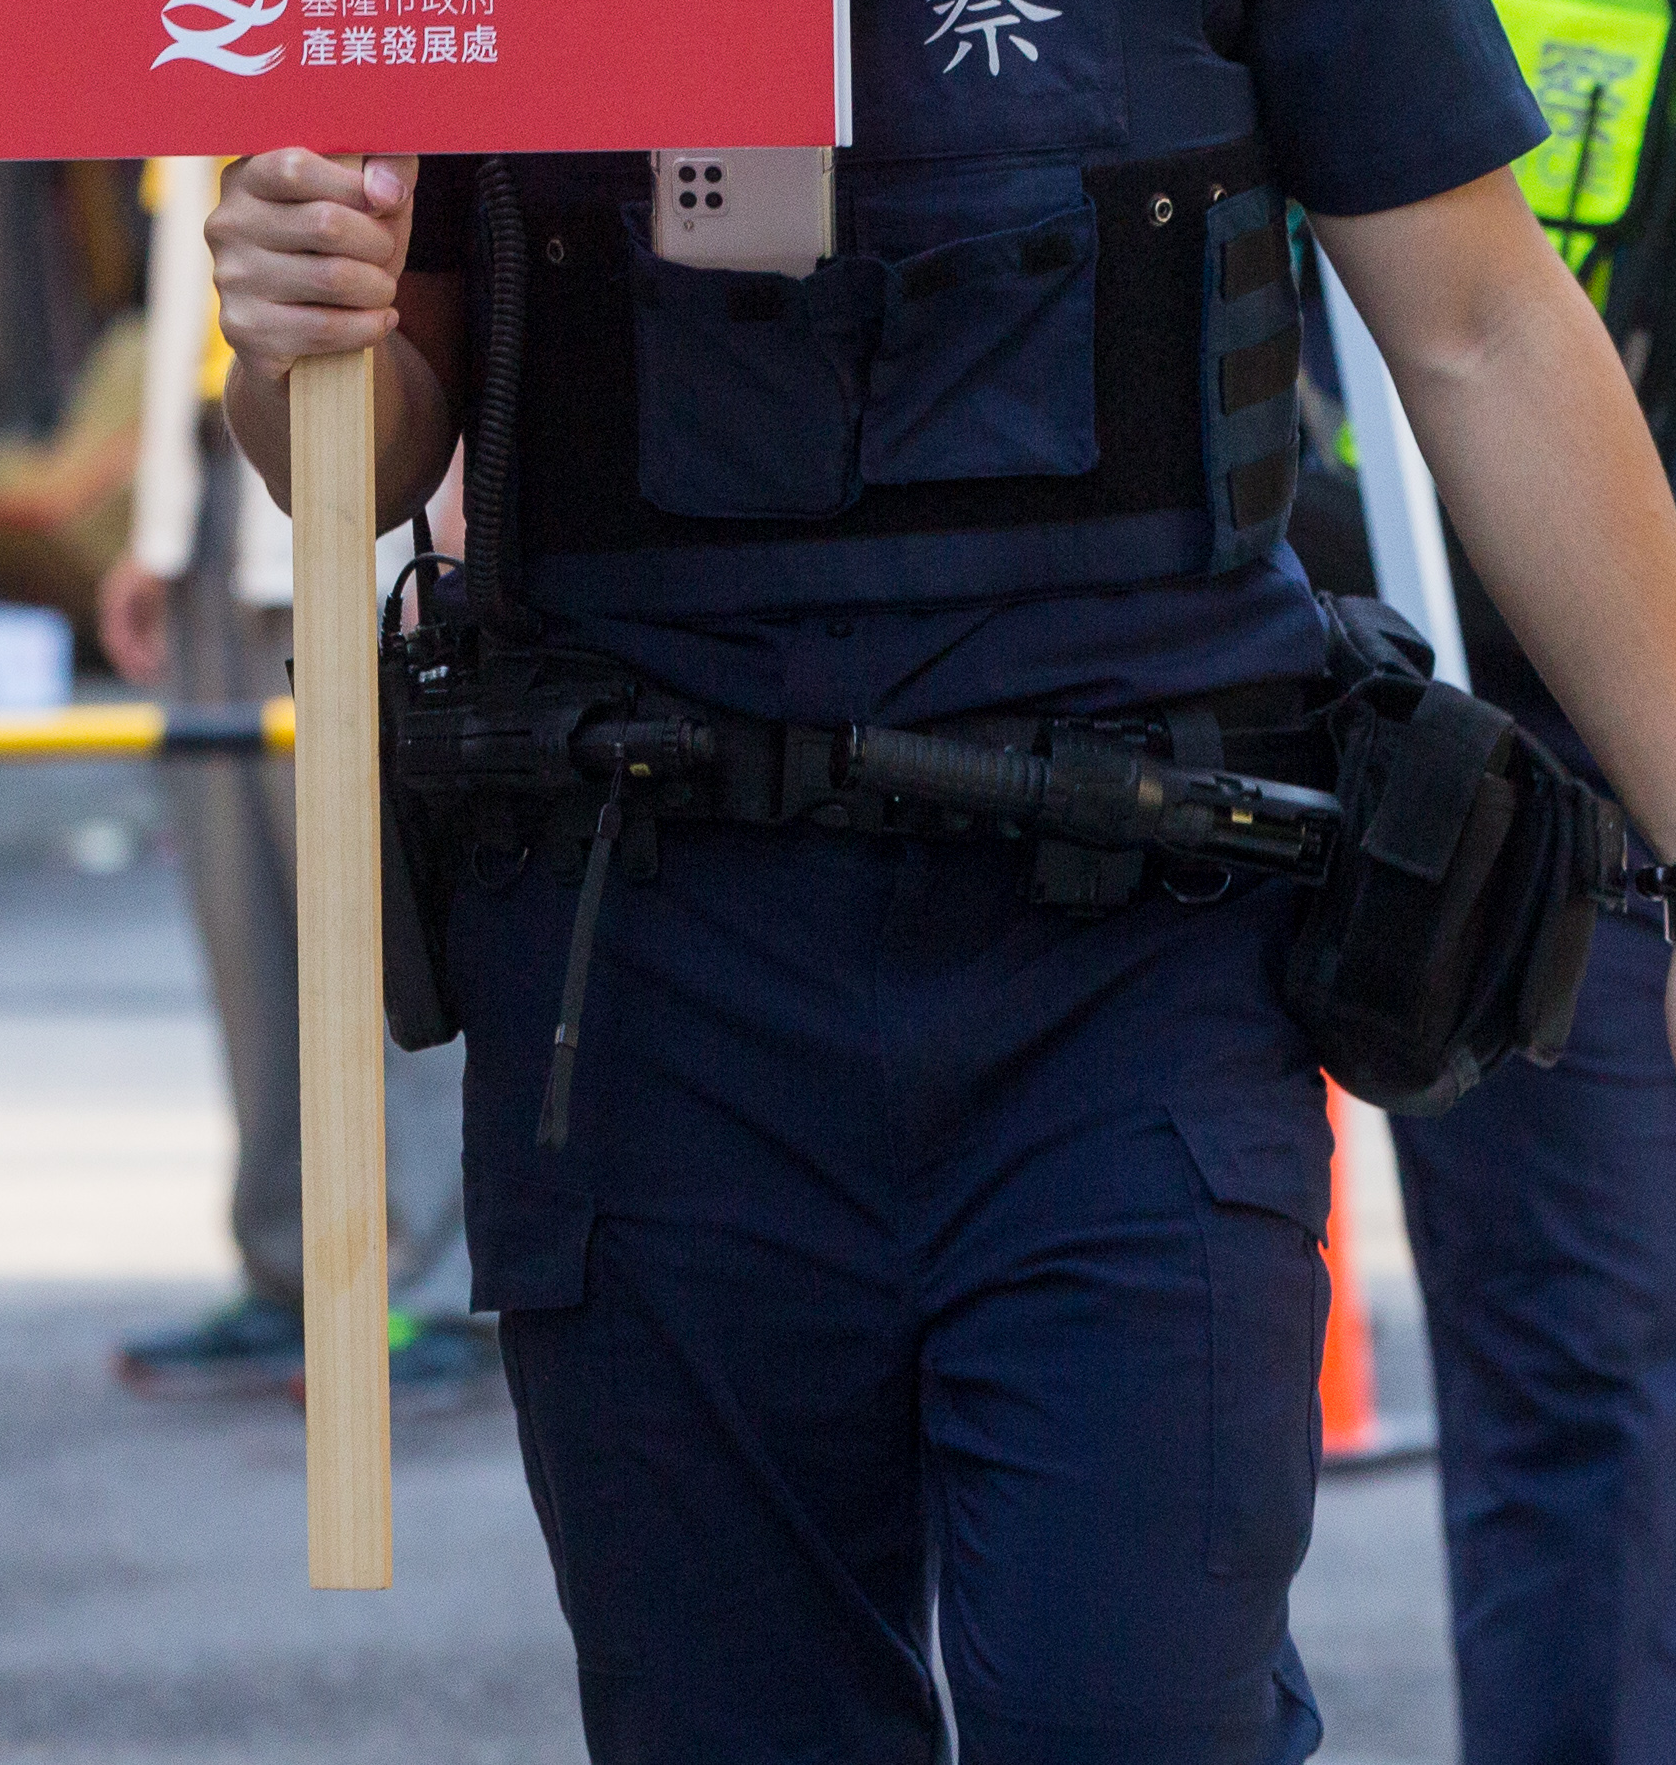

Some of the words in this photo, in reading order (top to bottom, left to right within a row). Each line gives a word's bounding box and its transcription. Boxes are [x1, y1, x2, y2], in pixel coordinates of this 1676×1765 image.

[300, 24, 498, 67] 產業發展處
